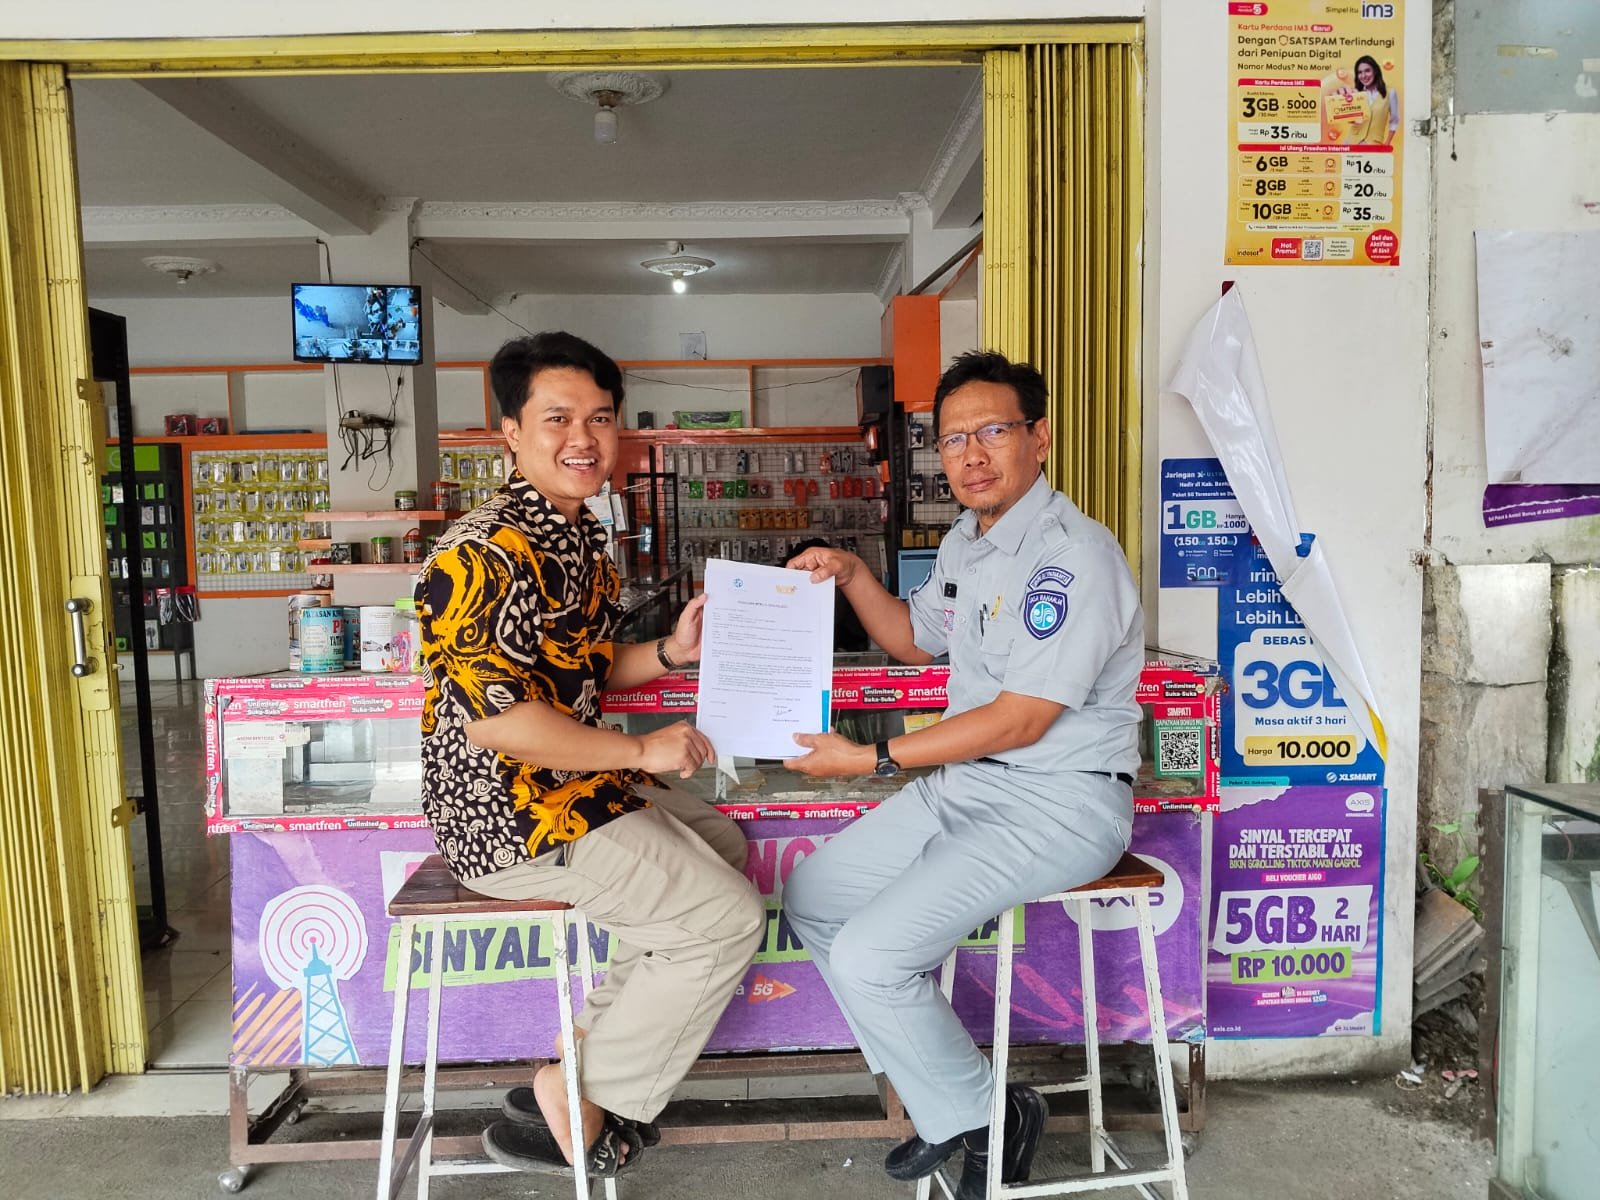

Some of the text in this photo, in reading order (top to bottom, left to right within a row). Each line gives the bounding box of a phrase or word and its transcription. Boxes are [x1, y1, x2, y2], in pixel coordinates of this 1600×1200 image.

[1252, 3, 1263, 15] 5
[1325, 6, 1359, 14] Simpel itu
[1261, 24, 1293, 32] Perdana
[1238, 36, 1395, 47] Dengan SATSPAM Terlindungi
[1238, 49, 1342, 60] dari Penipuan Digital
[1238, 63, 1264, 71] Nomor
[1266, 63, 1295, 71] Modus?
[1243, 97, 1279, 118] 3GB
[1287, 99, 1317, 110] 5000
[1259, 129, 1269, 137] Rp
[1270, 126, 1290, 139] 35
[1291, 130, 1308, 139] ribu
[1287, 145, 1302, 153] Ulang
[1356, 160, 1372, 173] 16
[1354, 184, 1374, 197] 20
[1343, 207, 1351, 215] Rp
[1353, 207, 1372, 221] 35
[1165, 471, 1195, 479] Jaringan
[1167, 504, 1217, 530] 1GB
[1225, 513, 1245, 521] Hanya
[1223, 520, 1246, 528] 1000
[1236, 589, 1280, 604] Lebih
[1236, 610, 1281, 625] Lebih
[1263, 636, 1306, 645] BEBAS
[606, 692, 657, 702] smartfren
[294, 698, 346, 709] smartfren
[1167, 707, 1191, 716] SIMPATI
[1255, 716, 1346, 726] Masa aktif 3 hari
[206, 718, 216, 771] smartfren
[1248, 740, 1351, 759] Harga 10.000
[1339, 773, 1377, 781] XLSMART
[804, 808, 855, 819] smartfren
[289, 820, 341, 832] smartfren
[347, 820, 379, 828] Unlimited
[1240, 829, 1352, 844] SINYAL TERCEPAT
[1229, 844, 1362, 859] DAN TERSTABIL AXIS
[1229, 859, 1361, 869] BIKIN SCROLLING TIKTOK MAKIN GASPOL
[1265, 874, 1279, 882] BELI
[1280, 874, 1307, 882] VOUCHER
[1225, 895, 1349, 944] 5GB 2
[1321, 925, 1361, 942] HARI
[408, 925, 551, 975] SINYAL
[1238, 952, 1345, 978] RP 10.000
[753, 983, 773, 996] 5G
